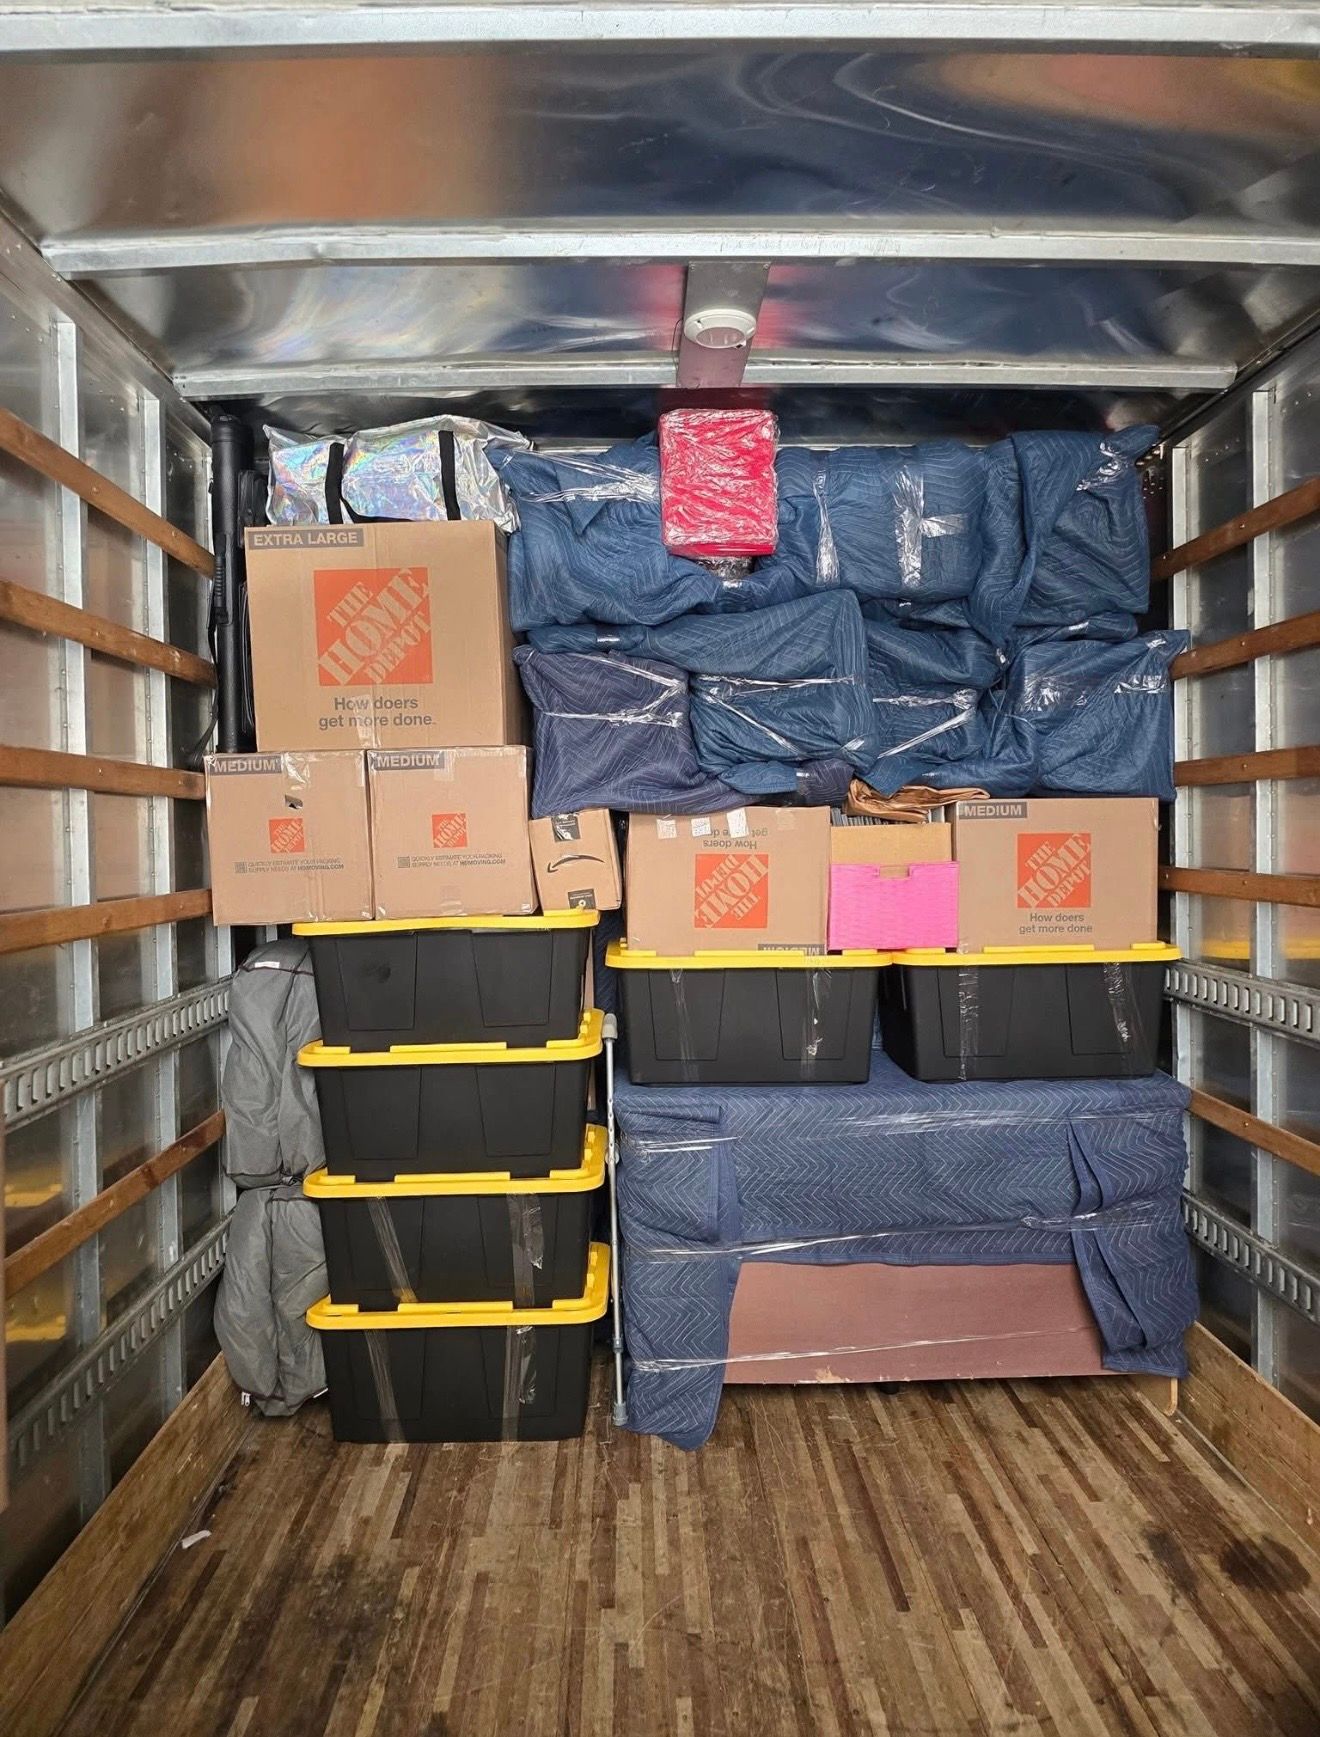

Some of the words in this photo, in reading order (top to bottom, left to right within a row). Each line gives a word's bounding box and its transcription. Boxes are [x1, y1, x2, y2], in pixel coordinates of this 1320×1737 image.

[253, 532, 303, 547] EXTRA
[307, 531, 358, 545] LARGE
[326, 581, 374, 628] THE
[317, 567, 430, 686] HOME
[363, 611, 432, 685] DEPOT
[334, 697, 369, 711] How
[373, 696, 418, 710] doers
[319, 714, 345, 731] get
[349, 715, 389, 727] more
[214, 758, 276, 773] MEDIUM
[377, 753, 440, 768] MEDIUM
[963, 804, 1022, 817] MEDIUM
[703, 840, 732, 849] doers
[735, 840, 757, 849] How
[1024, 840, 1056, 871] THE
[695, 854, 740, 901] DEPOT
[1017, 833, 1090, 909] HOME
[1046, 859, 1091, 907] DEPOT
[694, 856, 769, 929] HOME
[731, 892, 761, 921] THE
[1029, 912, 1053, 922] How
[1055, 912, 1084, 922] doers
[1019, 924, 1036, 935] get
[1038, 925, 1064, 934] more
